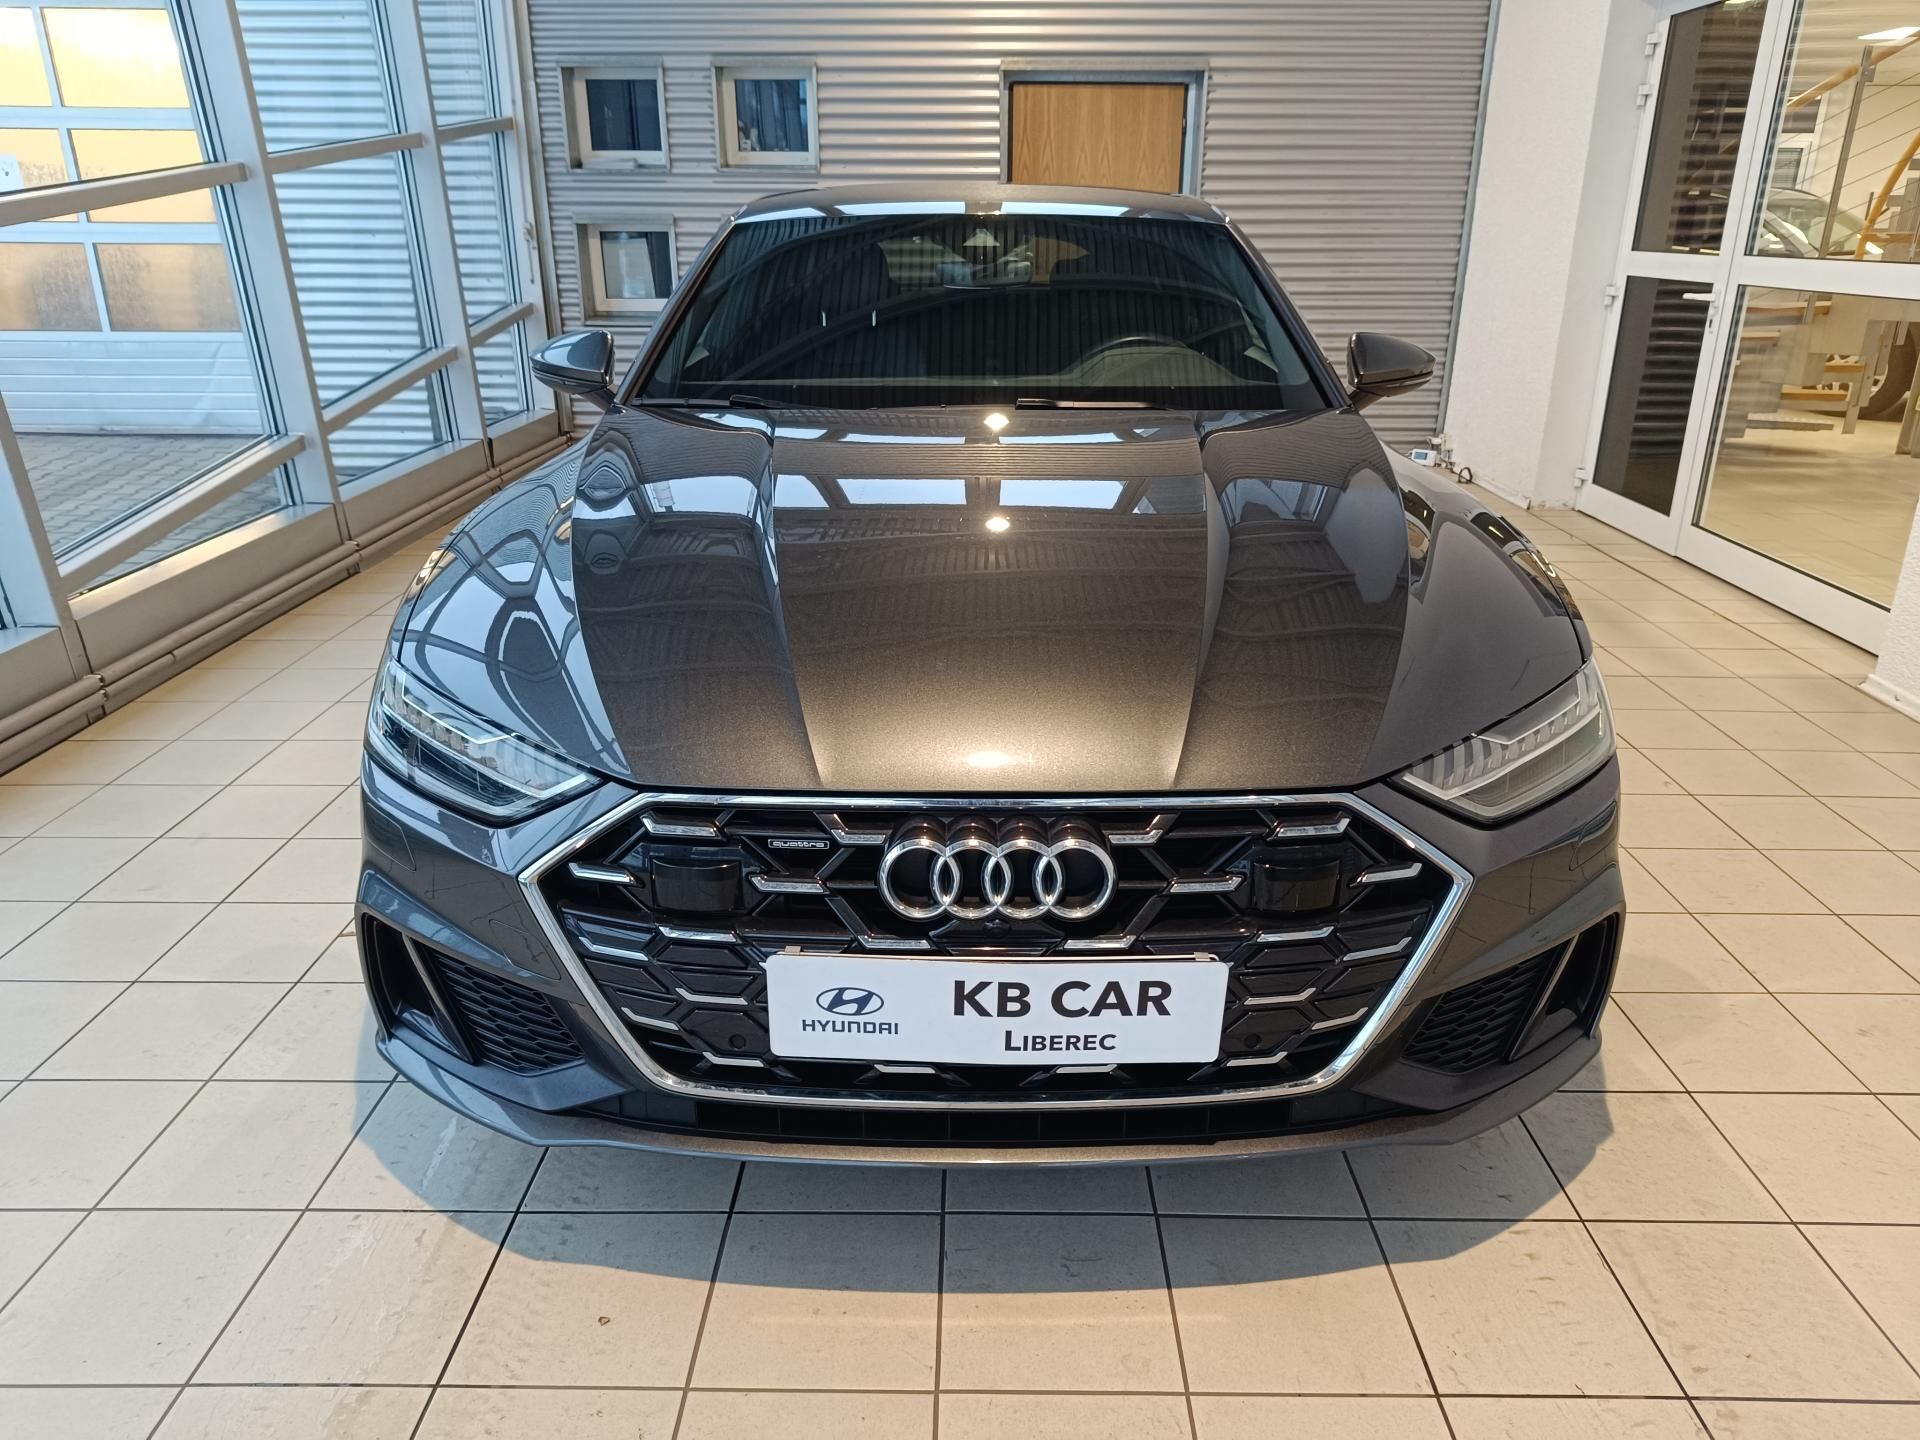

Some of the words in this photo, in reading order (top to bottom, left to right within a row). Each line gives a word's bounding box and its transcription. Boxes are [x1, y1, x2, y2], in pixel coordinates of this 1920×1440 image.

[771, 840, 827, 849] quattro
[953, 980, 1031, 1018] KB
[1051, 980, 1172, 1018] CAR
[802, 1018, 899, 1035] HYUNDAI
[1004, 1030, 1117, 1051] LIBEREC
